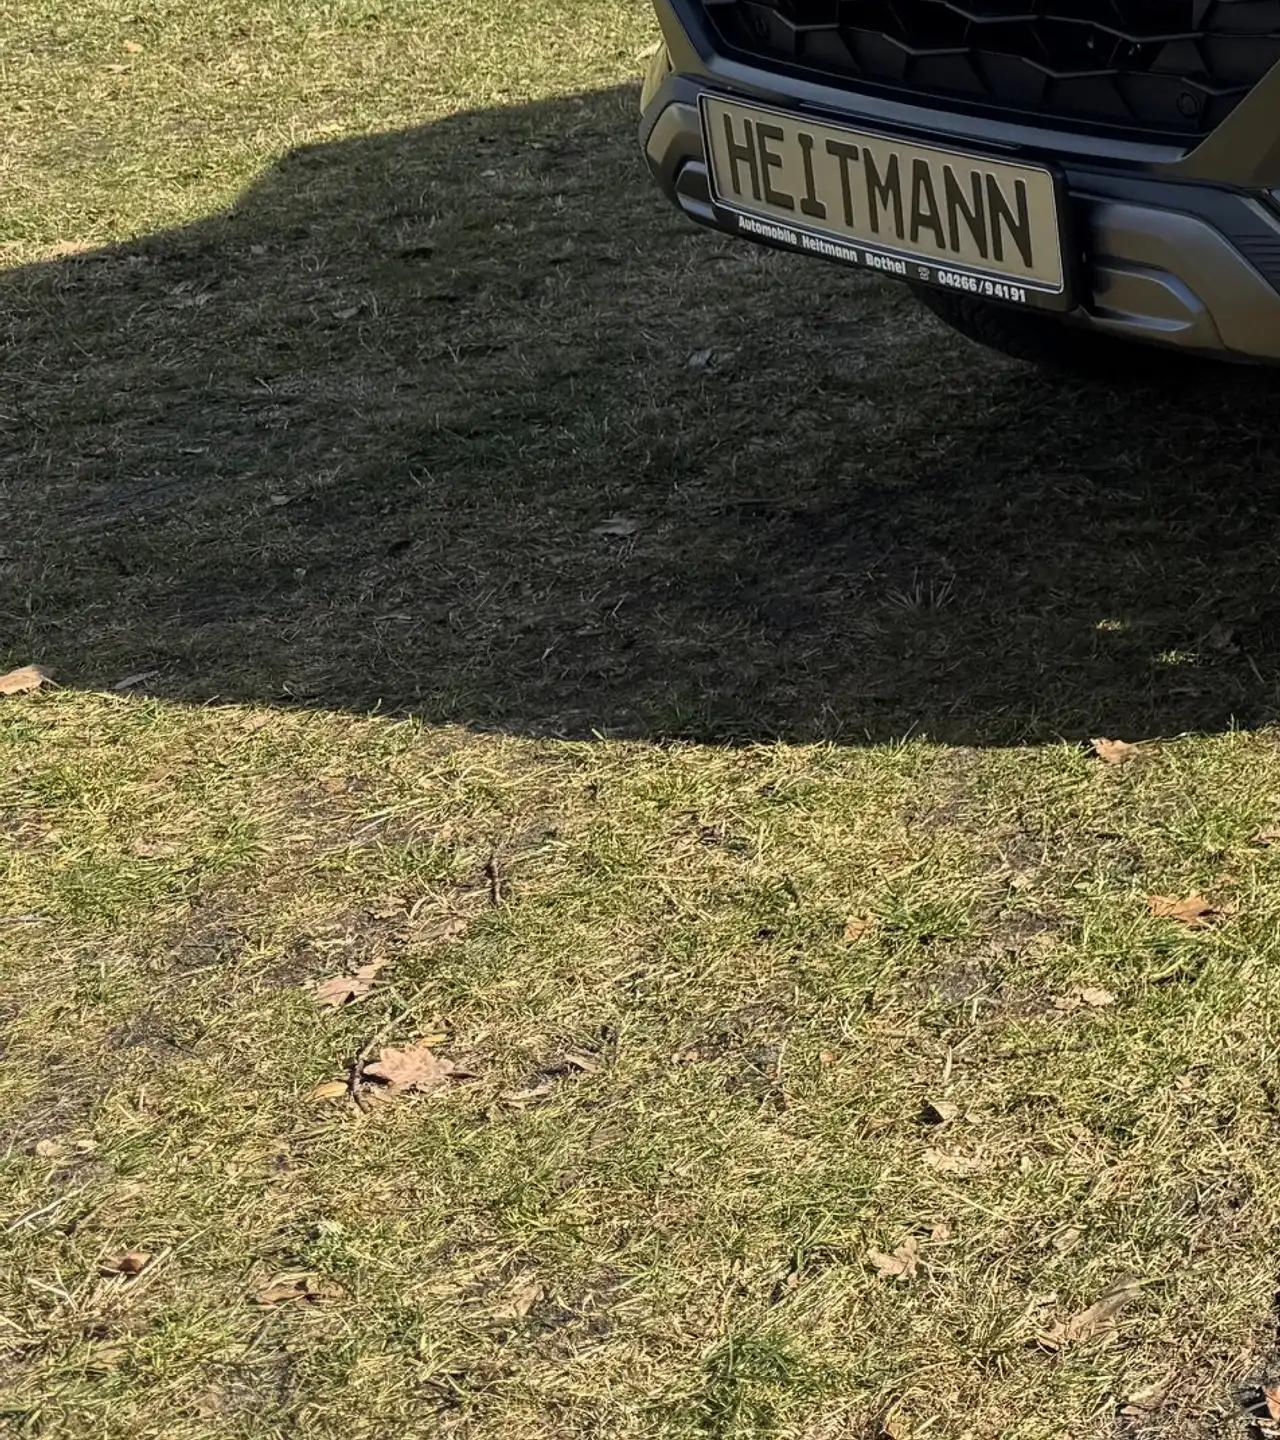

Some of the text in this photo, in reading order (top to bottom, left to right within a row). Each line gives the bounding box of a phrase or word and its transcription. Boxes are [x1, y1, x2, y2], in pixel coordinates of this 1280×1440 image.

[724, 113, 1033, 268] HEITMANN
[738, 215, 1026, 302] Automobile Heitmann Bothel 04266/94191
